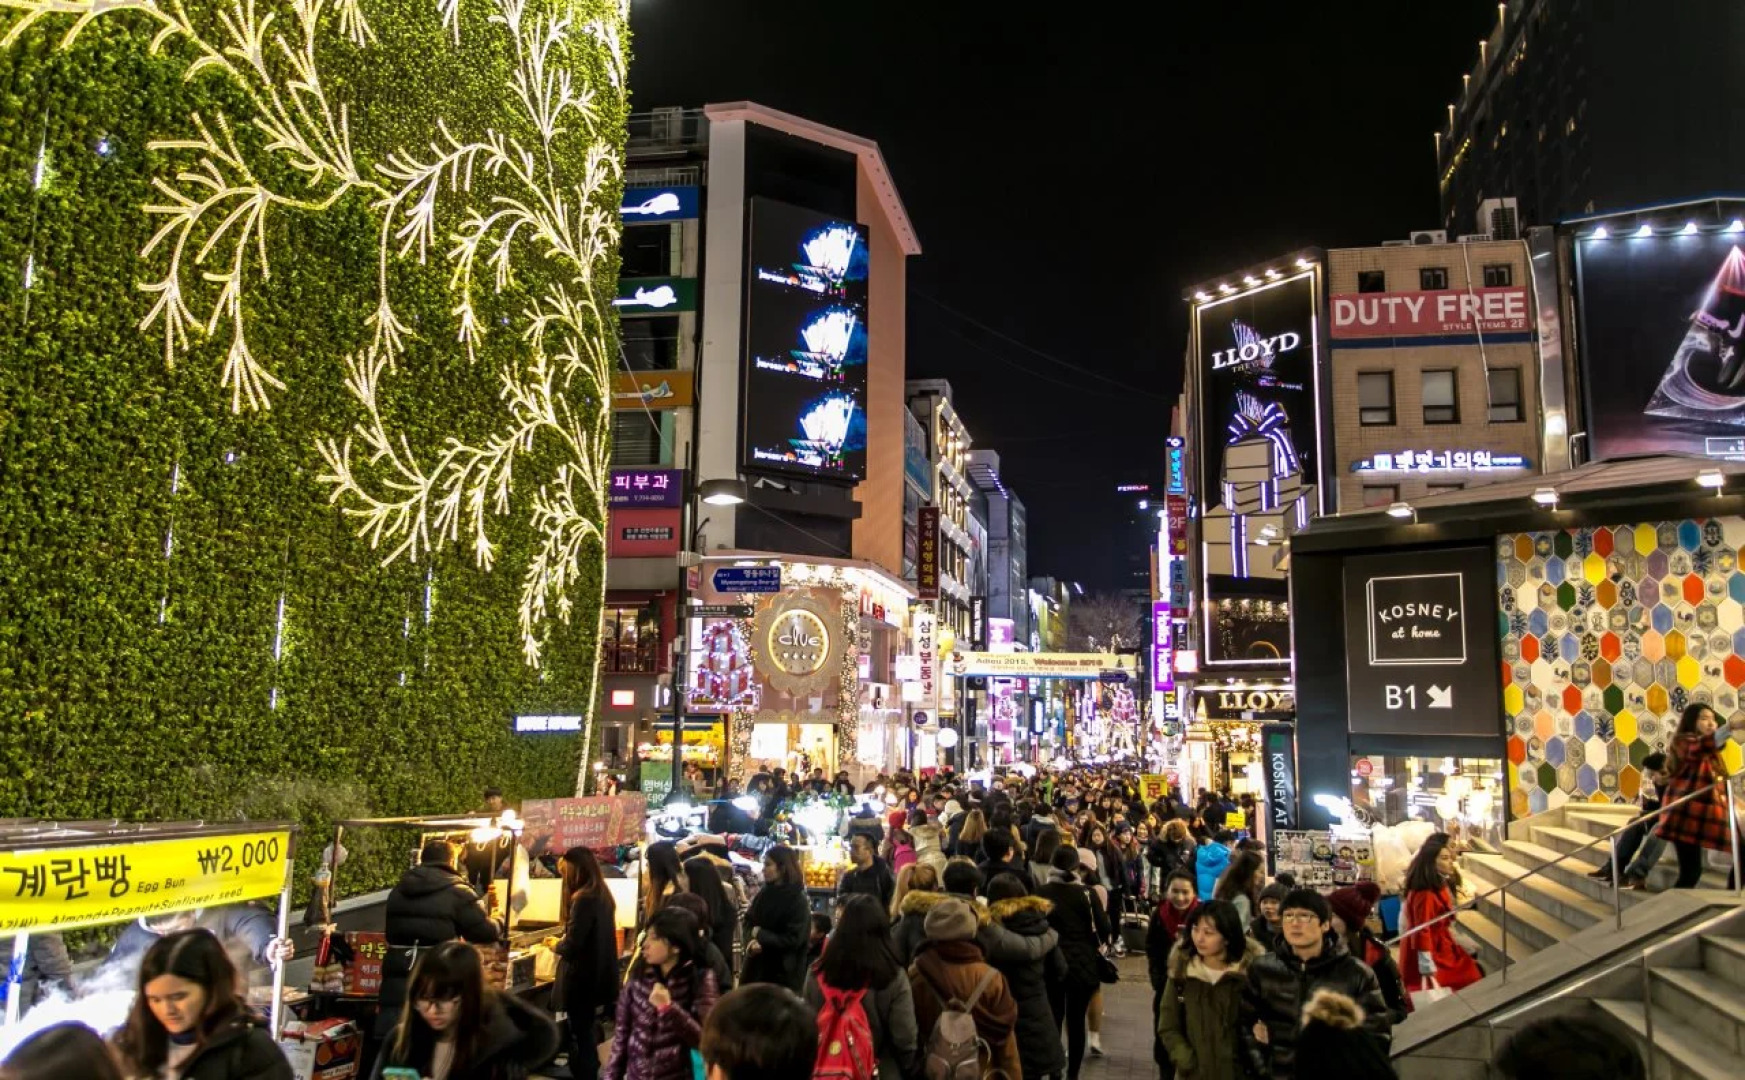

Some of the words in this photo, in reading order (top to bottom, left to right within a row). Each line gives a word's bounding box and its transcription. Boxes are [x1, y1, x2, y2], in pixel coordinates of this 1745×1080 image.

[1335, 296, 1429, 326] DUTY
[1437, 291, 1526, 322] FREE
[1442, 322, 1472, 331] STYLE
[1211, 331, 1300, 370] LLOYD
[614, 474, 670, 490] 피부과
[1169, 516, 1186, 529] 2F
[1378, 603, 1459, 623] KOSNEY
[777, 627, 821, 647] clue
[1391, 626, 1405, 638] at
[1411, 625, 1441, 639] home
[1004, 658, 1028, 666] 2015,
[1033, 658, 1078, 666] Welcome
[1079, 658, 1104, 666] 2016
[1218, 692, 1286, 709] LLOY
[1385, 685, 1416, 710] B1
[1272, 753, 1286, 804] KOSNEY
[1275, 808, 1288, 825] AT
[3, 854, 131, 900] 계란빵
[197, 837, 279, 876] ₩2,000
[137, 881, 159, 894] Egg
[165, 878, 185, 888] Bun
[218, 886, 244, 900] seed
